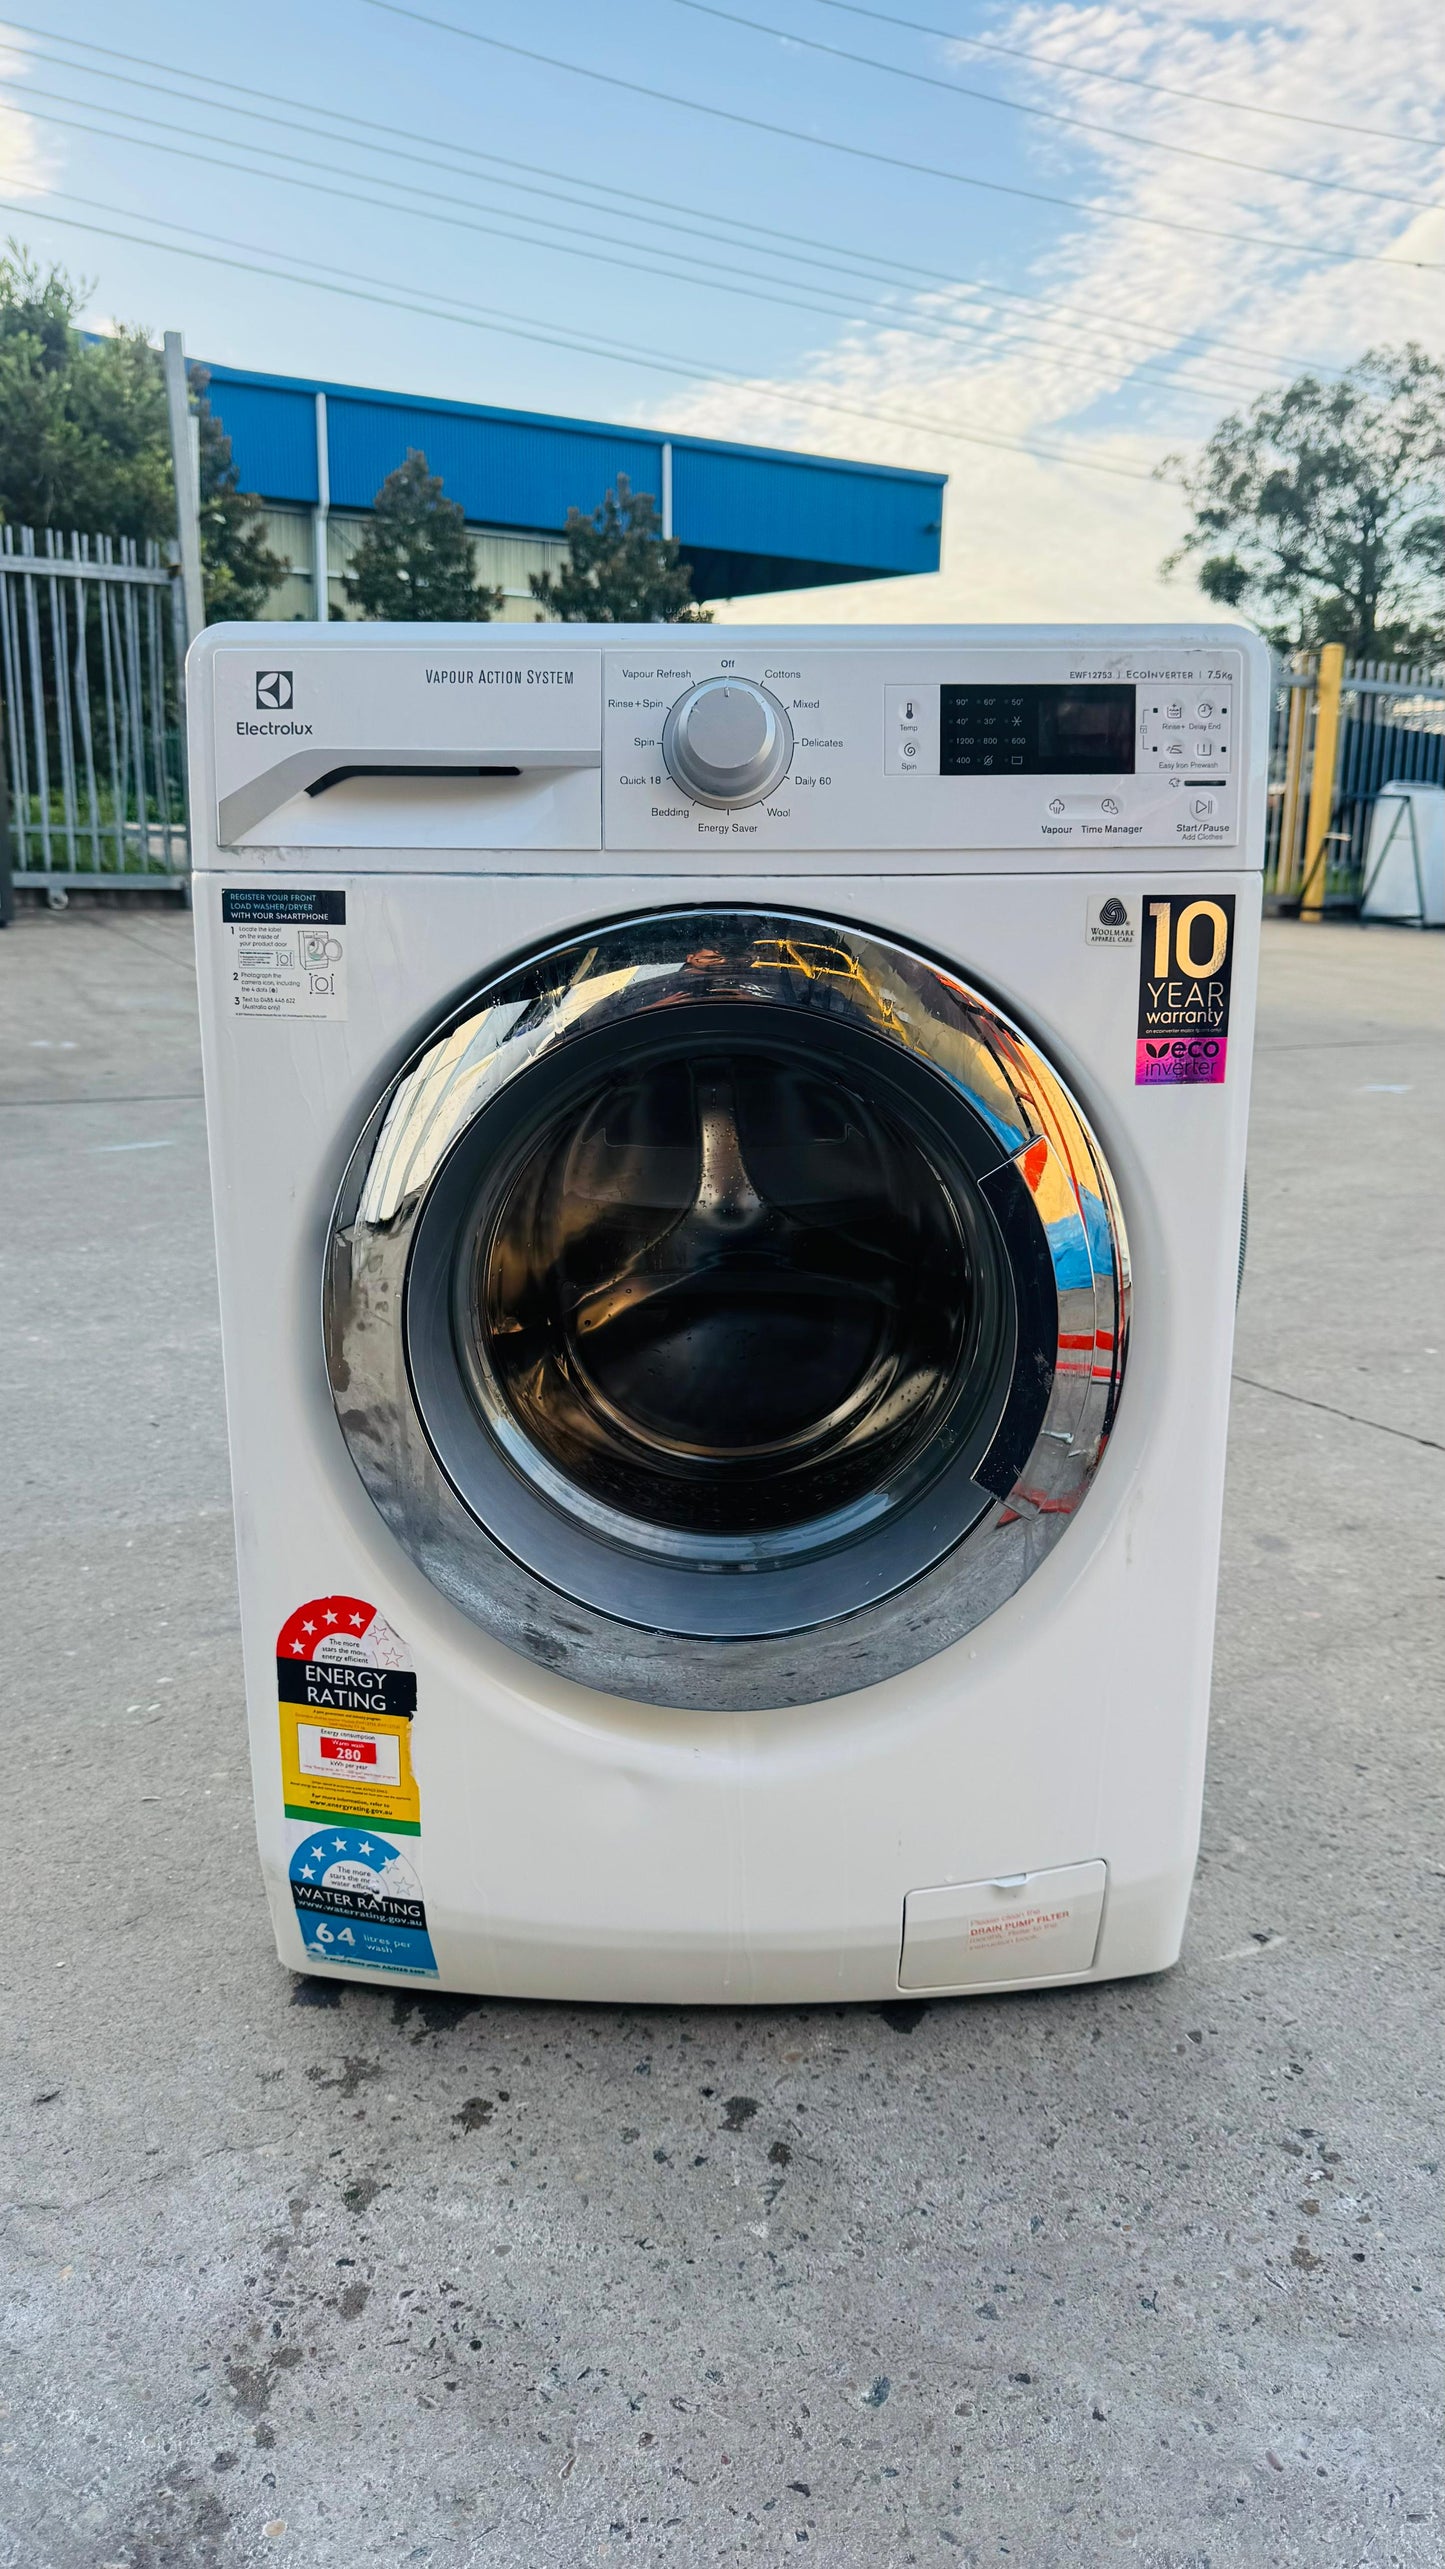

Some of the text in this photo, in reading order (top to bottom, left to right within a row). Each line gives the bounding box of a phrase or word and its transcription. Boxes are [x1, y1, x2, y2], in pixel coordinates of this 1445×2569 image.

[721, 660, 735, 669] Off
[425, 668, 574, 685] VAPOUR ACTION SYSTEM
[622, 670, 692, 680] Vapour Refresh
[764, 669, 801, 679] Cottons
[793, 700, 820, 709] Mixed
[236, 721, 313, 736] Electrolux
[900, 724, 918, 733] Temp
[1188, 723, 1206, 731] Delay
[634, 738, 655, 748] Spin
[801, 738, 843, 748] Delicates
[956, 737, 974, 745] 1200
[983, 737, 998, 745] 800
[1011, 737, 1026, 745] 600
[956, 756, 971, 764] 400
[1158, 761, 1174, 769] Easy
[901, 762, 917, 771] Spin
[620, 776, 661, 786] Quick 18
[795, 776, 831, 787] Daily 60
[651, 807, 689, 818] Bedding
[767, 808, 791, 817] Wool
[698, 823, 758, 834] Energy Saver
[1041, 825, 1073, 835] Vapour
[1081, 825, 1143, 836] Time Manager
[1176, 823, 1230, 832] Start/Pause
[1181, 833, 1223, 841] Add Clothes
[230, 893, 265, 901] REGISTER
[290, 894, 316, 902] FRONT
[230, 902, 313, 911] LOAD WASHER/DRYER
[252, 912, 274, 920] YOUR
[276, 913, 329, 921] SMARTPHONE
[230, 926, 235, 935] 1
[1091, 927, 1135, 937] WOOLMARK
[1149, 900, 1228, 978] 10
[233, 972, 239, 980] 2
[1147, 981, 1224, 1008] YEAR
[234, 996, 240, 1005] 3
[1146, 1008, 1224, 1027] warranty
[1171, 1041, 1220, 1059] eco
[1145, 1059, 1217, 1077] inverter
[329, 1638, 360, 1648] The more
[322, 1653, 369, 1664] energy efficient
[305, 1664, 387, 1690] ENERGY
[307, 1686, 386, 1711] RATING
[320, 1728, 376, 1741] Energy consumption
[336, 1747, 361, 1761] 280
[356, 1763, 368, 1771] year
[309, 1799, 393, 1815] www.energyrating.gov.au
[330, 1872, 346, 1880] stars
[337, 1865, 371, 1877] The more
[331, 1879, 350, 1888] water
[294, 1885, 421, 1917] WATER RATING
[299, 1900, 422, 1927] www.waterrating.gov.au
[970, 1924, 1002, 1936] DRAIN
[1004, 1918, 1035, 1930] PUMP
[1036, 1910, 1070, 1924] FILTER
[315, 1923, 356, 1946] 64
[363, 1934, 411, 1949] litres per
[366, 1945, 392, 1953] wash
